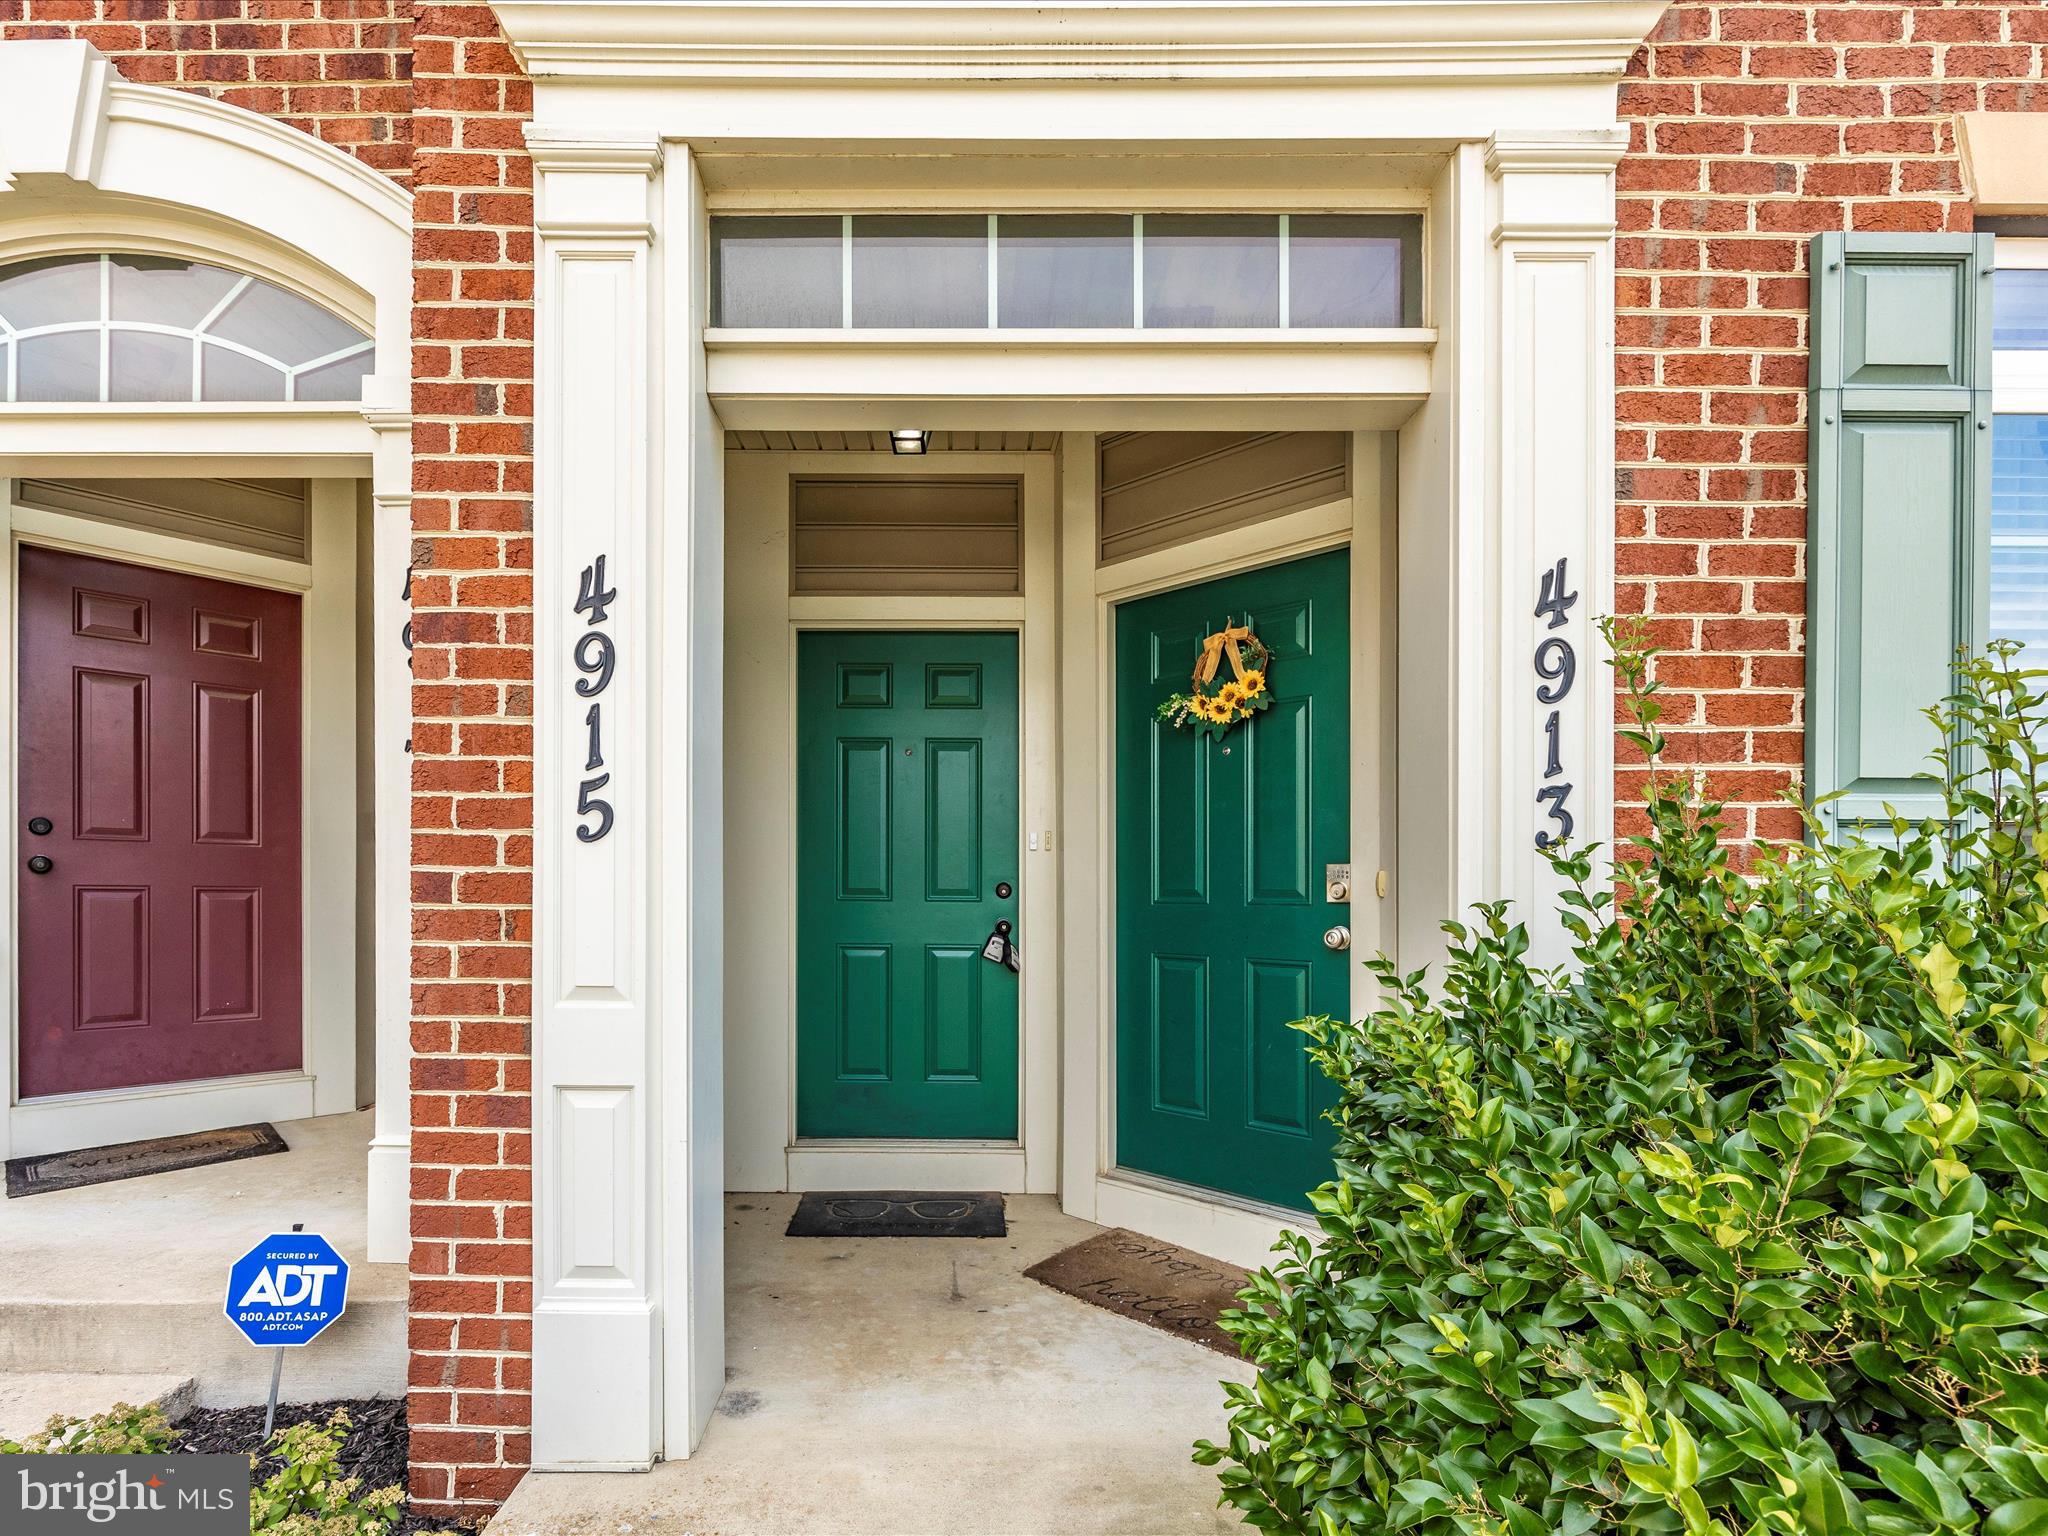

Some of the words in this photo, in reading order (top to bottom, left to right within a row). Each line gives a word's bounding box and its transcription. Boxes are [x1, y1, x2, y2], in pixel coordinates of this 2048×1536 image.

[573, 554, 617, 843] 4915
[1534, 557, 1579, 850] 4913
[68, 1138, 233, 1170] WELCOME
[266, 1252, 306, 1260] SECURED
[308, 1252, 319, 1260] BY
[1112, 1241, 1251, 1290] odbye
[237, 1264, 338, 1307] ADT
[1079, 1277, 1211, 1329] hello
[239, 1311, 329, 1322] 800.ADT.ASAP
[262, 1323, 304, 1331] ADT.COM
